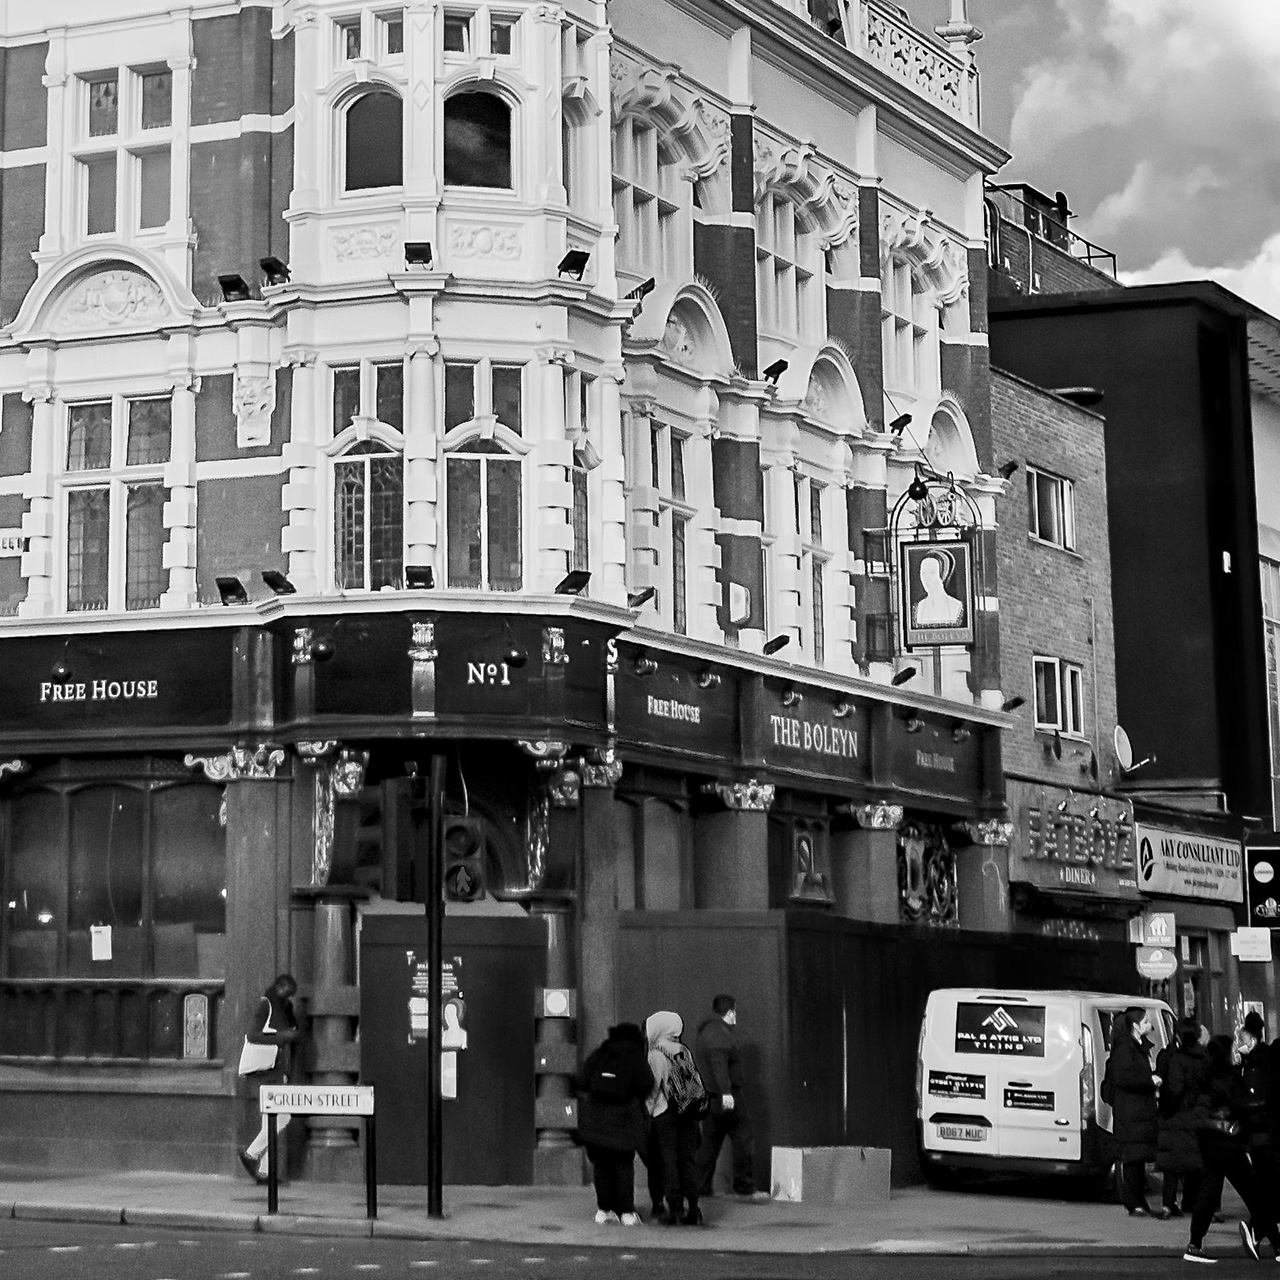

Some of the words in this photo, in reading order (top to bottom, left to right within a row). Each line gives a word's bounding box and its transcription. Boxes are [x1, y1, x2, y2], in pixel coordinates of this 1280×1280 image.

[40, 682, 86, 701] FREE
[92, 680, 158, 699] HOUSE
[648, 695, 670, 716] FREE
[671, 700, 700, 724] HOUSE
[770, 714, 800, 749] THE
[803, 721, 858, 758] BOLEYN
[1176, 840, 1224, 865] CONSULTANT
[1225, 848, 1240, 868] LTD
[1065, 867, 1093, 885] DINER
[974, 1041, 1024, 1050] TILING
[274, 1092, 313, 1106] GREEN
[317, 1094, 359, 1107] STREET
